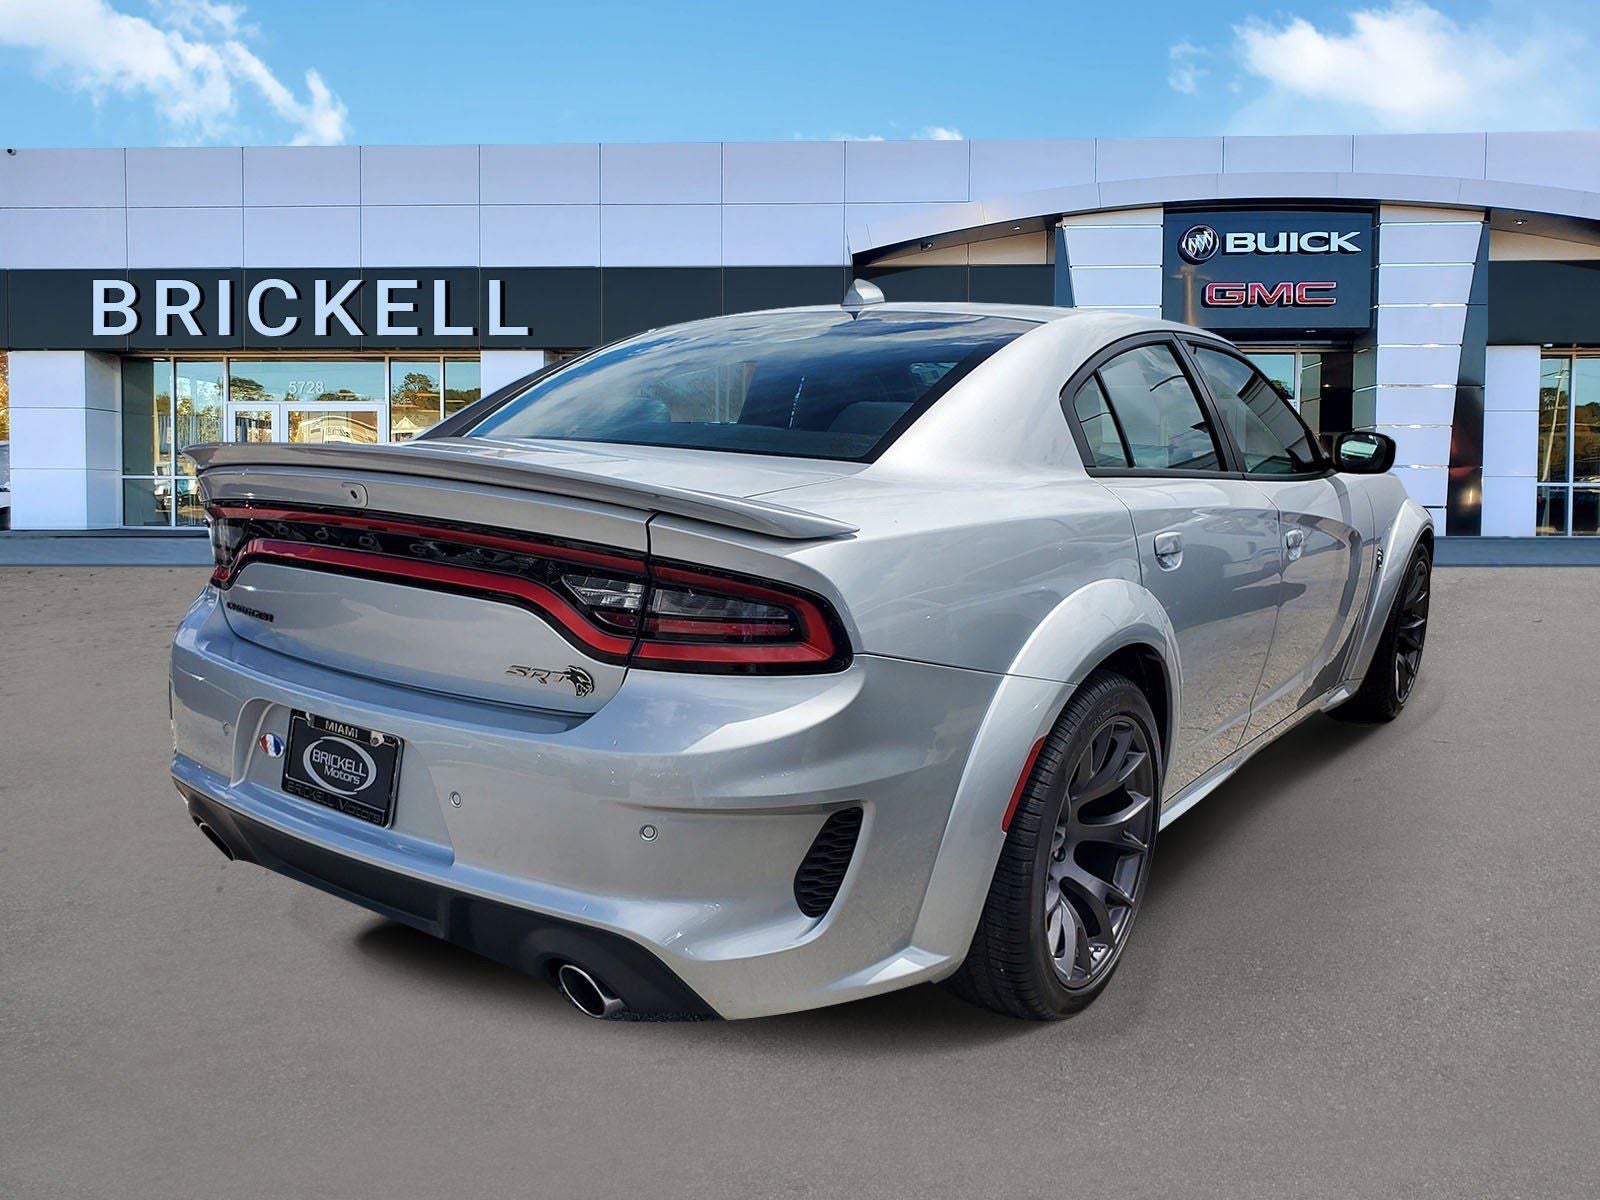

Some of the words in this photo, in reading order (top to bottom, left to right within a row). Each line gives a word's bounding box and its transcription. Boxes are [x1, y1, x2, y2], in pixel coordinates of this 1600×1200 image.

[1226, 231, 1361, 253] BUICK
[1206, 282, 1337, 305] GMC
[92, 279, 530, 337] BRICKELL
[288, 381, 325, 394] 5728
[505, 664, 568, 684] SRT
[325, 720, 358, 738] MIAMI
[312, 749, 367, 777] BRICKELL
[323, 766, 360, 785] Motors
